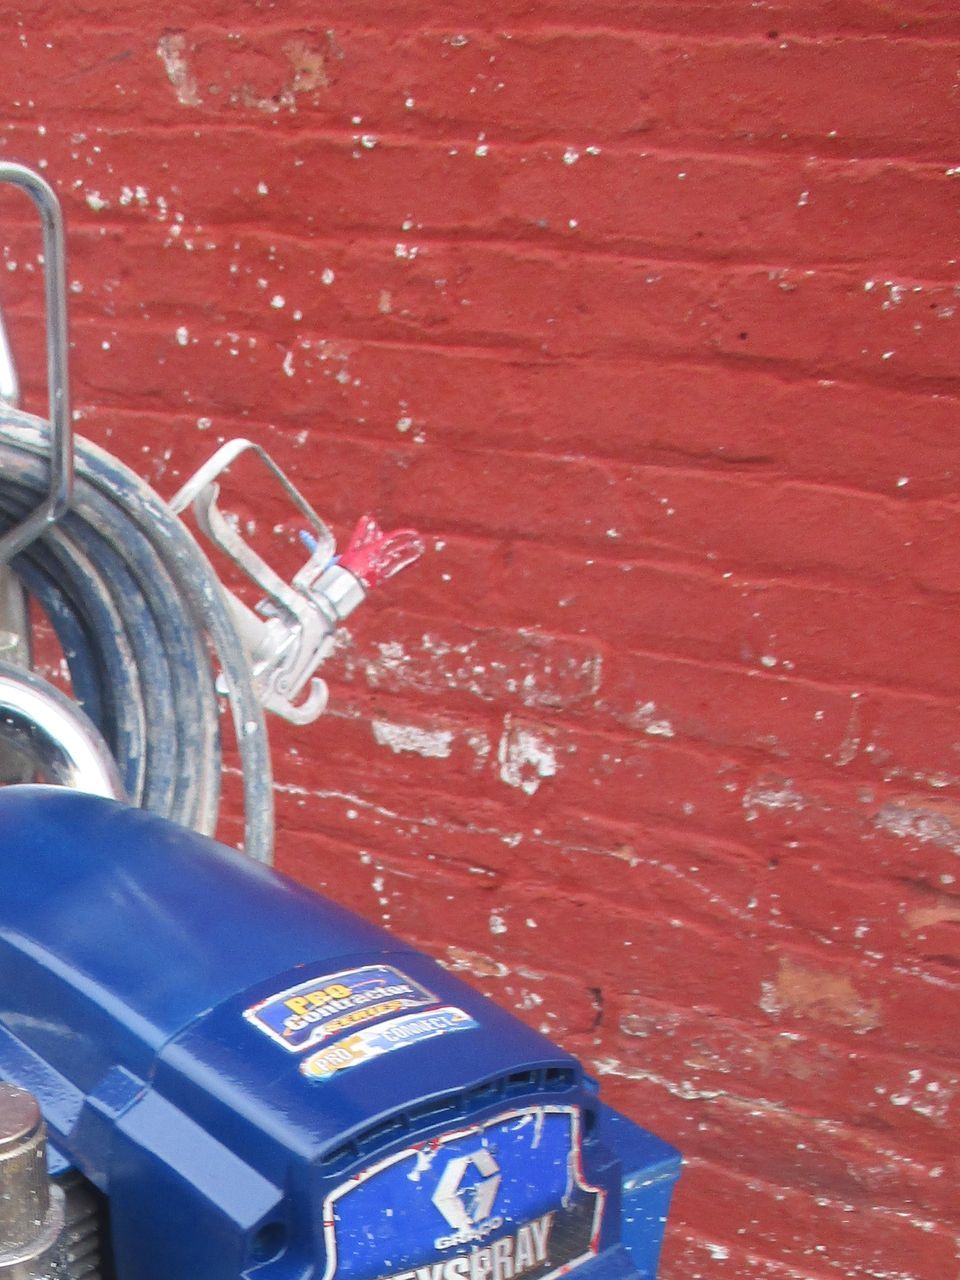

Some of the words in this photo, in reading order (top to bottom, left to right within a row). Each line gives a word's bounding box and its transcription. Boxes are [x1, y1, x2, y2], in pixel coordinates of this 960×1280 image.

[284, 983, 352, 1015] PRO
[284, 984, 413, 1031] Contractor
[382, 1016, 452, 1042] CONNECT
